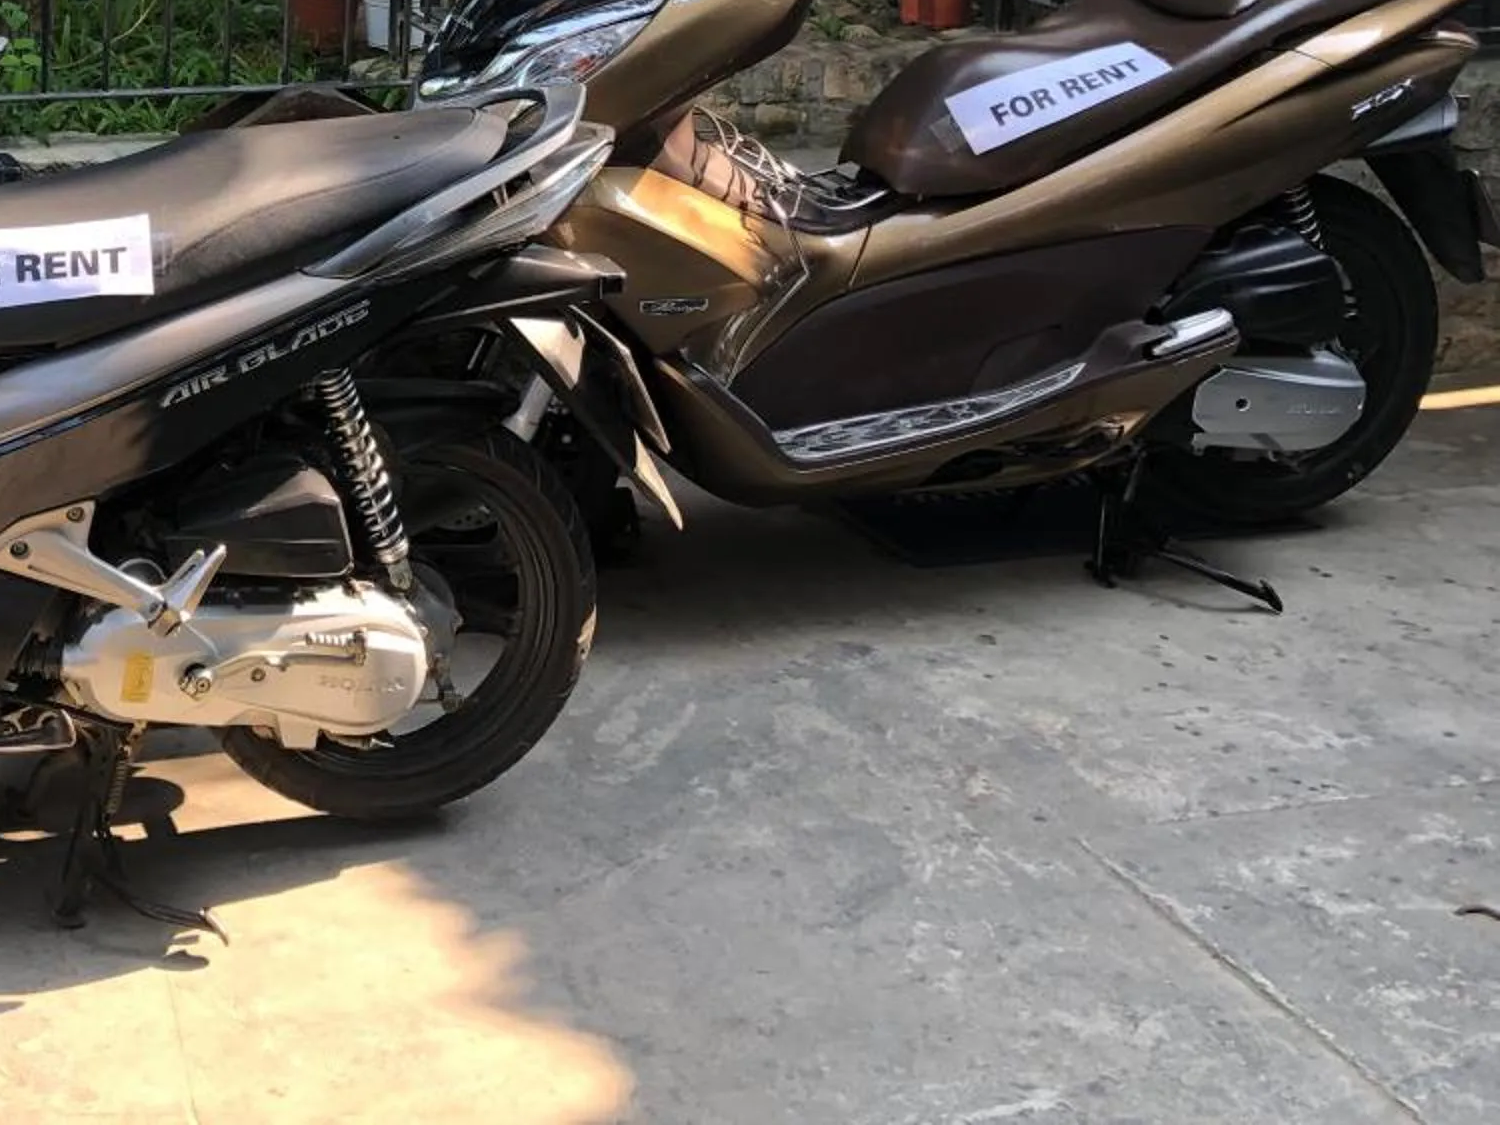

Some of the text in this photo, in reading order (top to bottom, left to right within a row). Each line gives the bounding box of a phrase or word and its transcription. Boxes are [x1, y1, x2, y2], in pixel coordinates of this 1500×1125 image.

[989, 57, 1141, 127] FOR RENT
[14, 246, 128, 284] RENT
[159, 297, 372, 409] AIR BLADE
